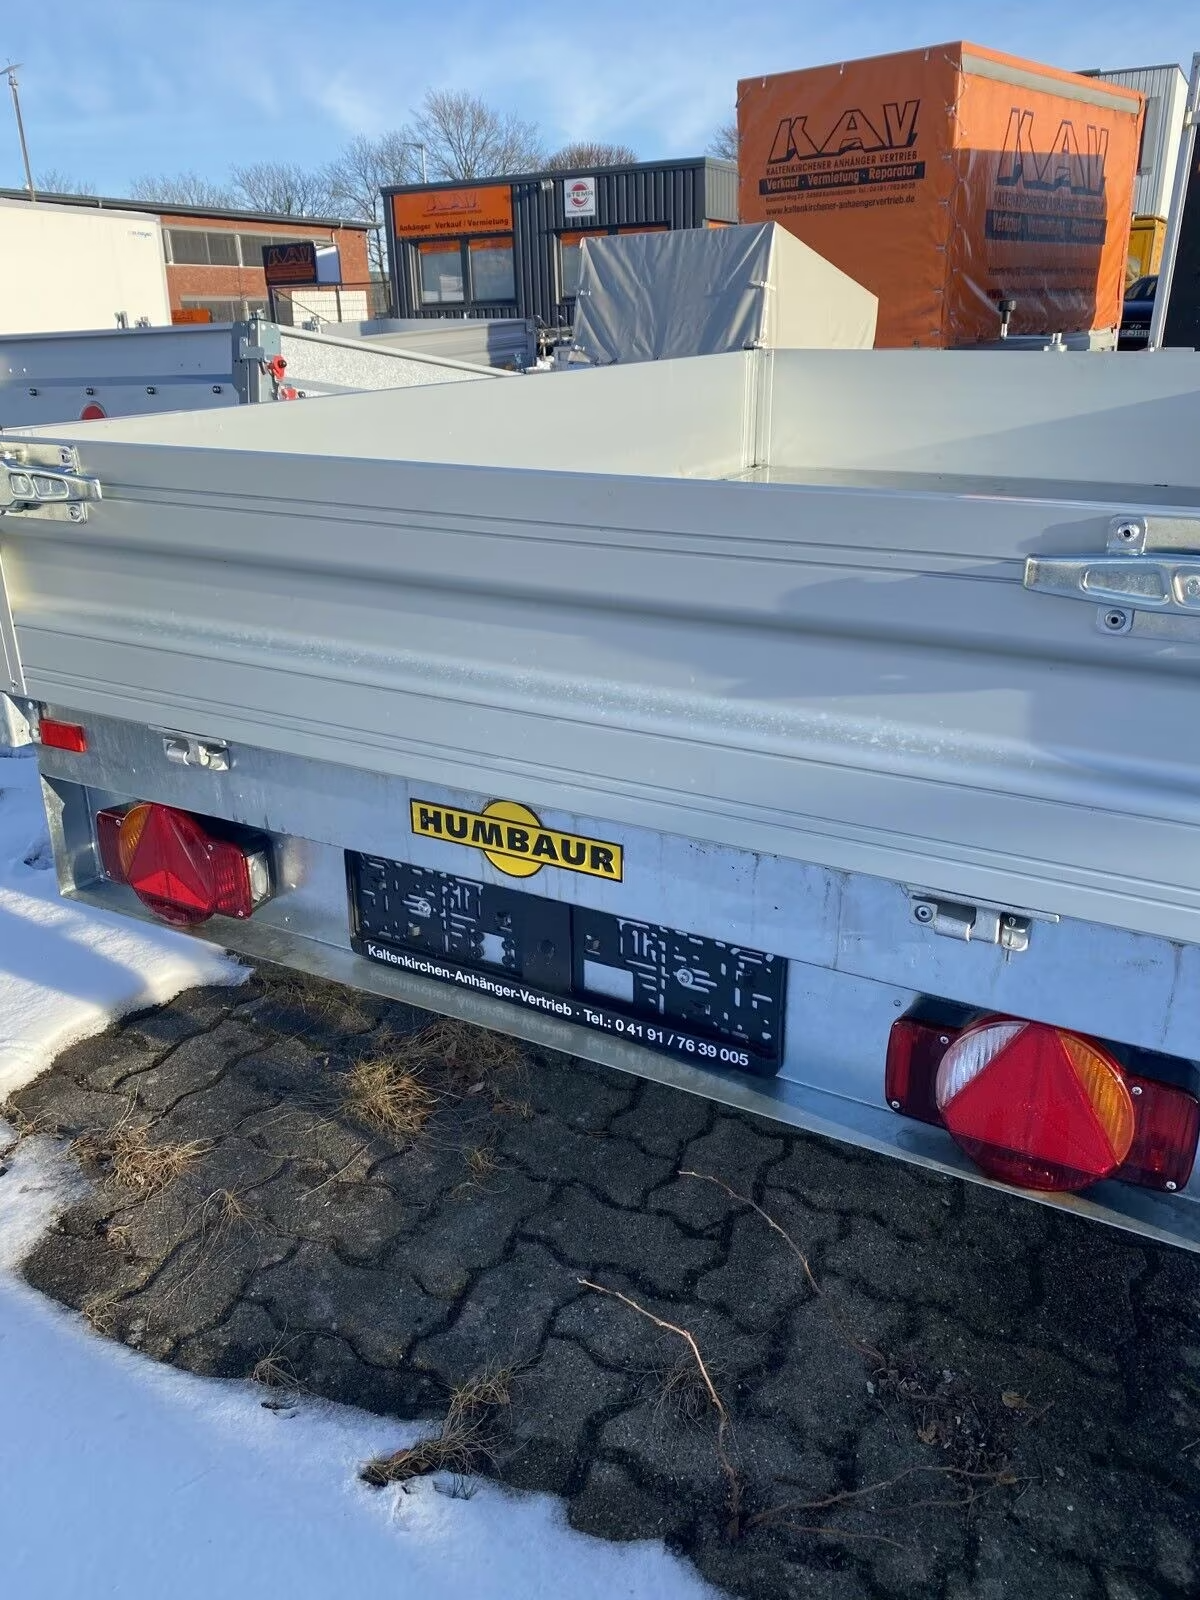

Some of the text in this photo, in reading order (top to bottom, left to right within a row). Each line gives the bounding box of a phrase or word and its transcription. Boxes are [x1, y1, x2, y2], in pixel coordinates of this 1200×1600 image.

[766, 150, 917, 175] KALTENKIRCHENER ANHÄNGER VERTRIEB
[767, 99, 921, 164] KAV
[996, 107, 1109, 197] KAV
[766, 165, 917, 191] Verkauf Vermietung Reparatur
[399, 223, 431, 232] Anhänger
[435, 221, 461, 229] Verkauf
[468, 218, 509, 227] Vermietung
[419, 807, 615, 874] HUMBAUR
[367, 944, 572, 1017] Kaltenkirchen-Anhänger-Vertrieb
[583, 1009, 612, 1029] Tel.:
